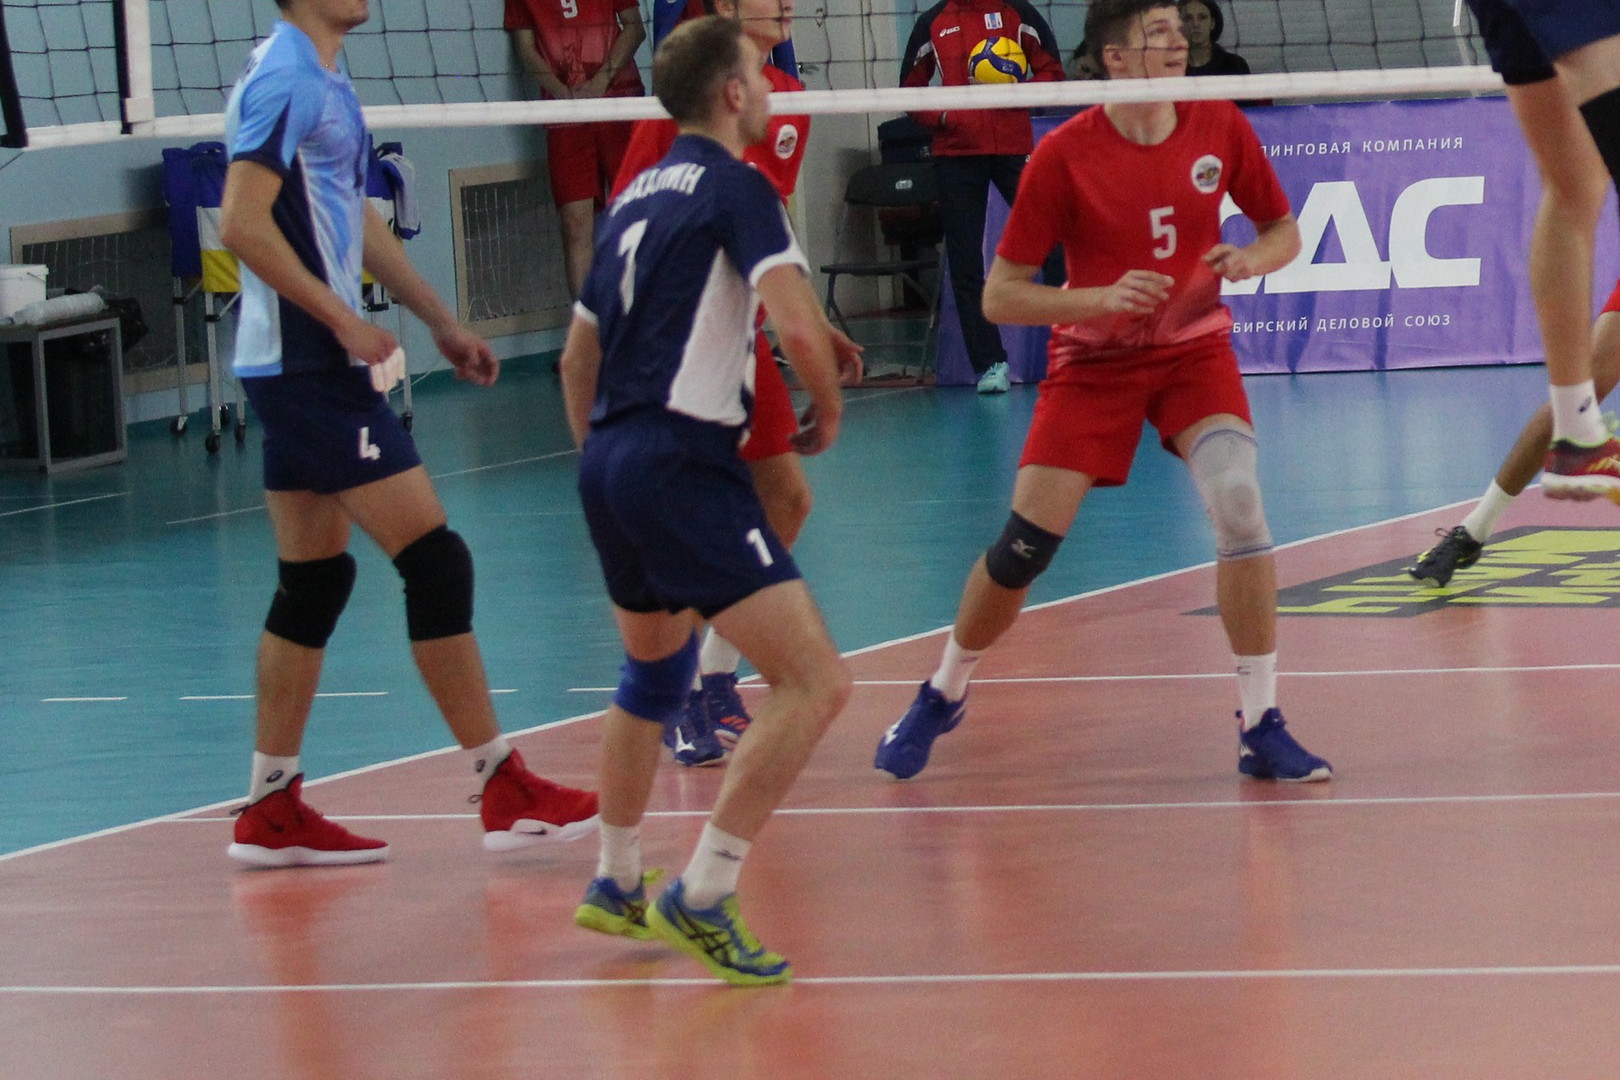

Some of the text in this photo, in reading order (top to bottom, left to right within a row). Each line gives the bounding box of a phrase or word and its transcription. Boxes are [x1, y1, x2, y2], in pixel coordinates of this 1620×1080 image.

[1362, 137, 1465, 153] КОМПАНИЯ
[1149, 206, 1178, 259] 5
[1316, 313, 1395, 333] ДЕЛОВОЙ
[1404, 314, 1451, 328] СОЮЗ
[746, 527, 774, 567] 1
